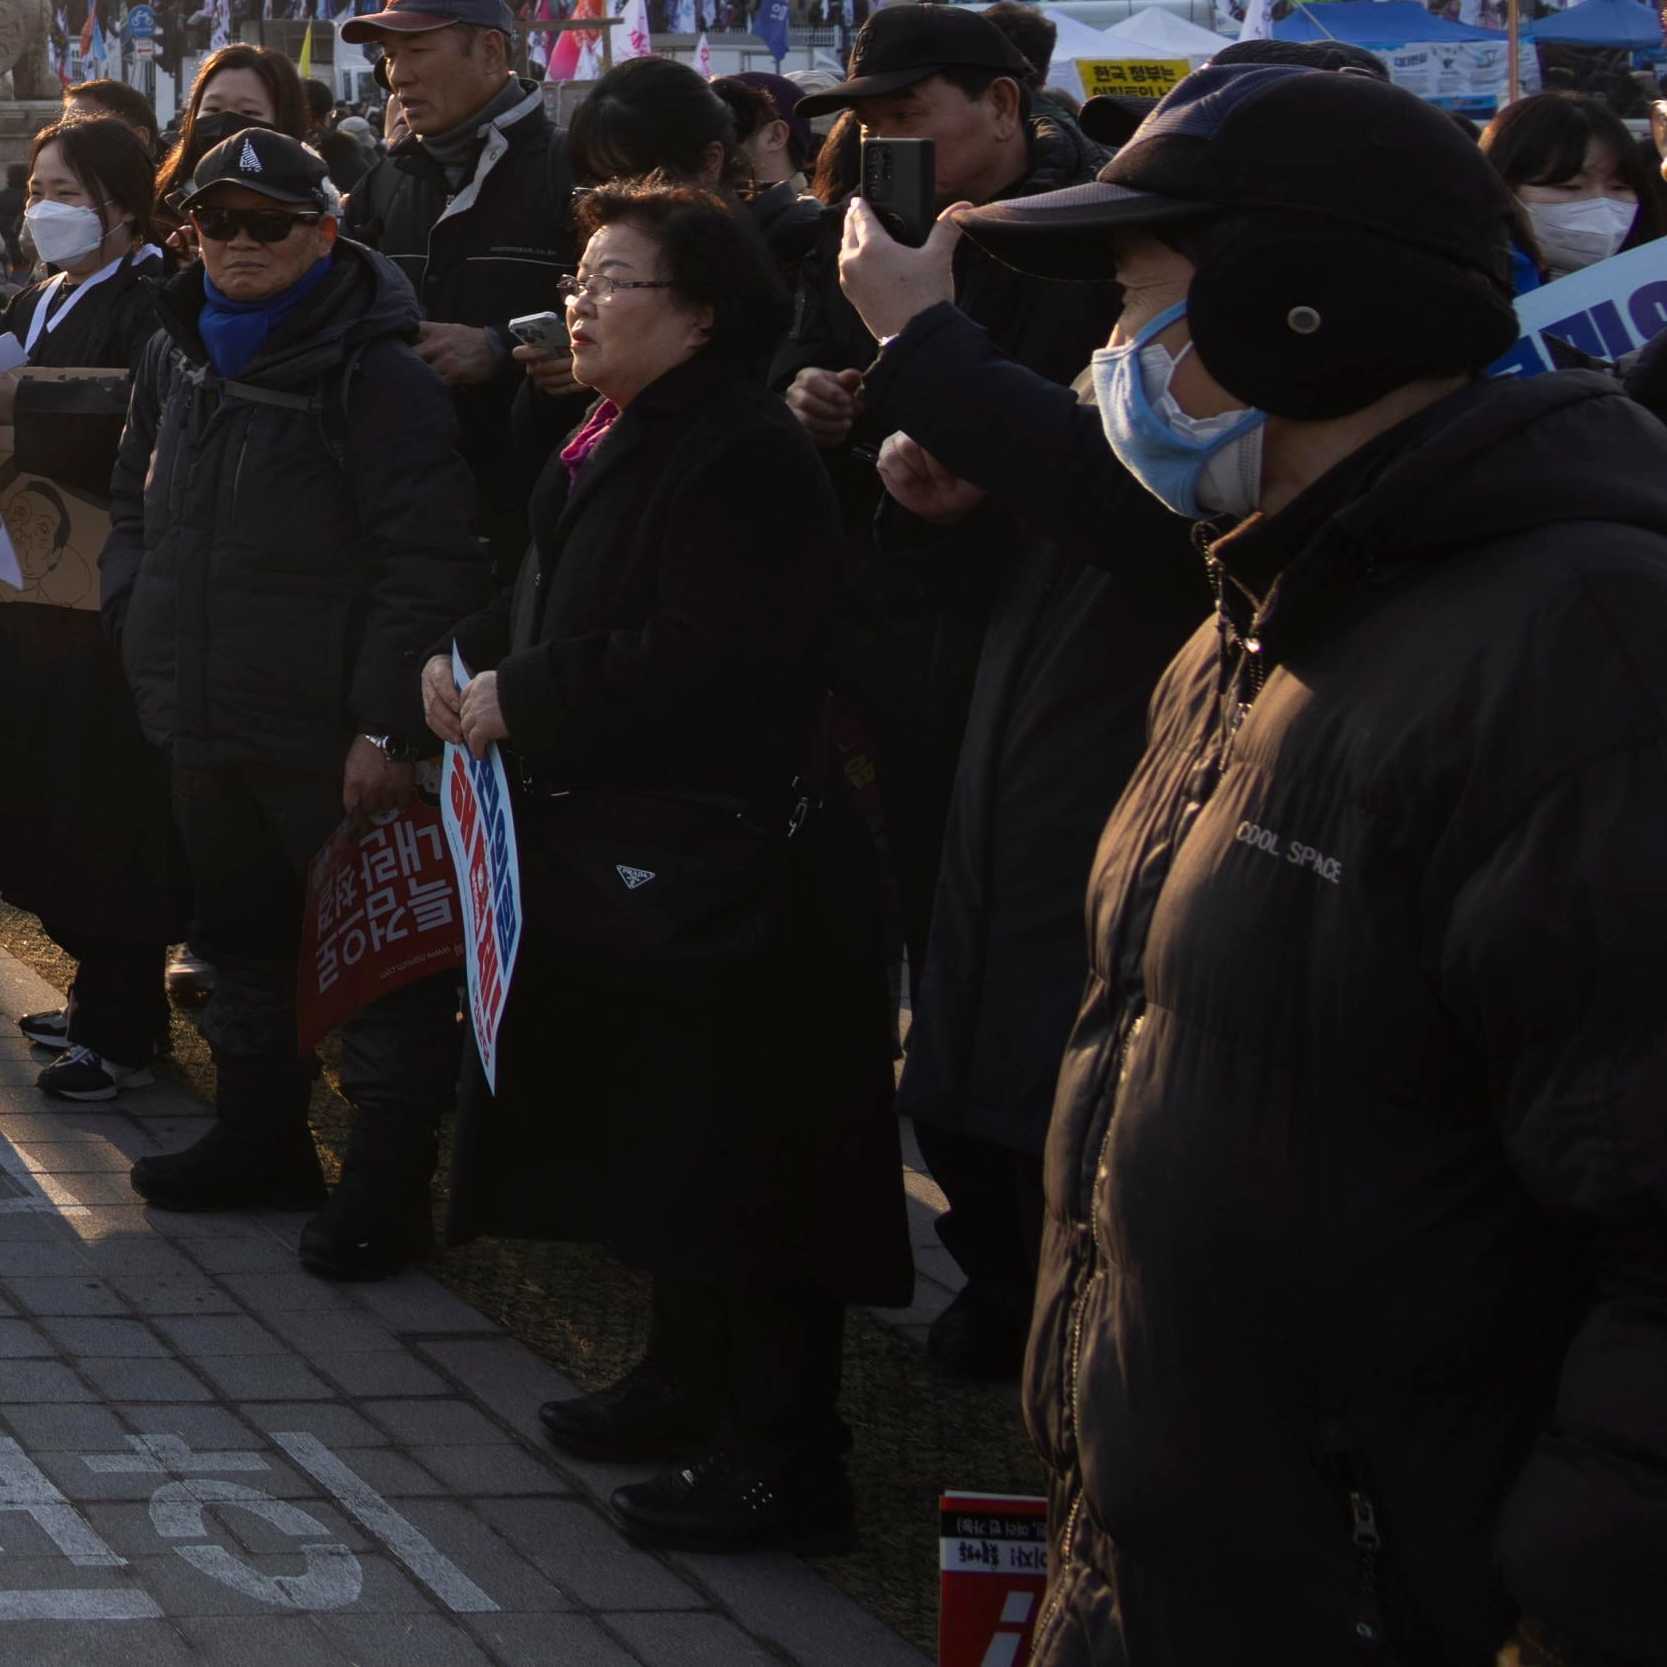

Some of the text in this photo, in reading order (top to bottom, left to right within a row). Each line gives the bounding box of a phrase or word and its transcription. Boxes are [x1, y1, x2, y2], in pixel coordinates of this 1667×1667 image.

[1093, 64, 1177, 83] 한국 정부는
[1236, 820, 1343, 884] COOL SPACE
